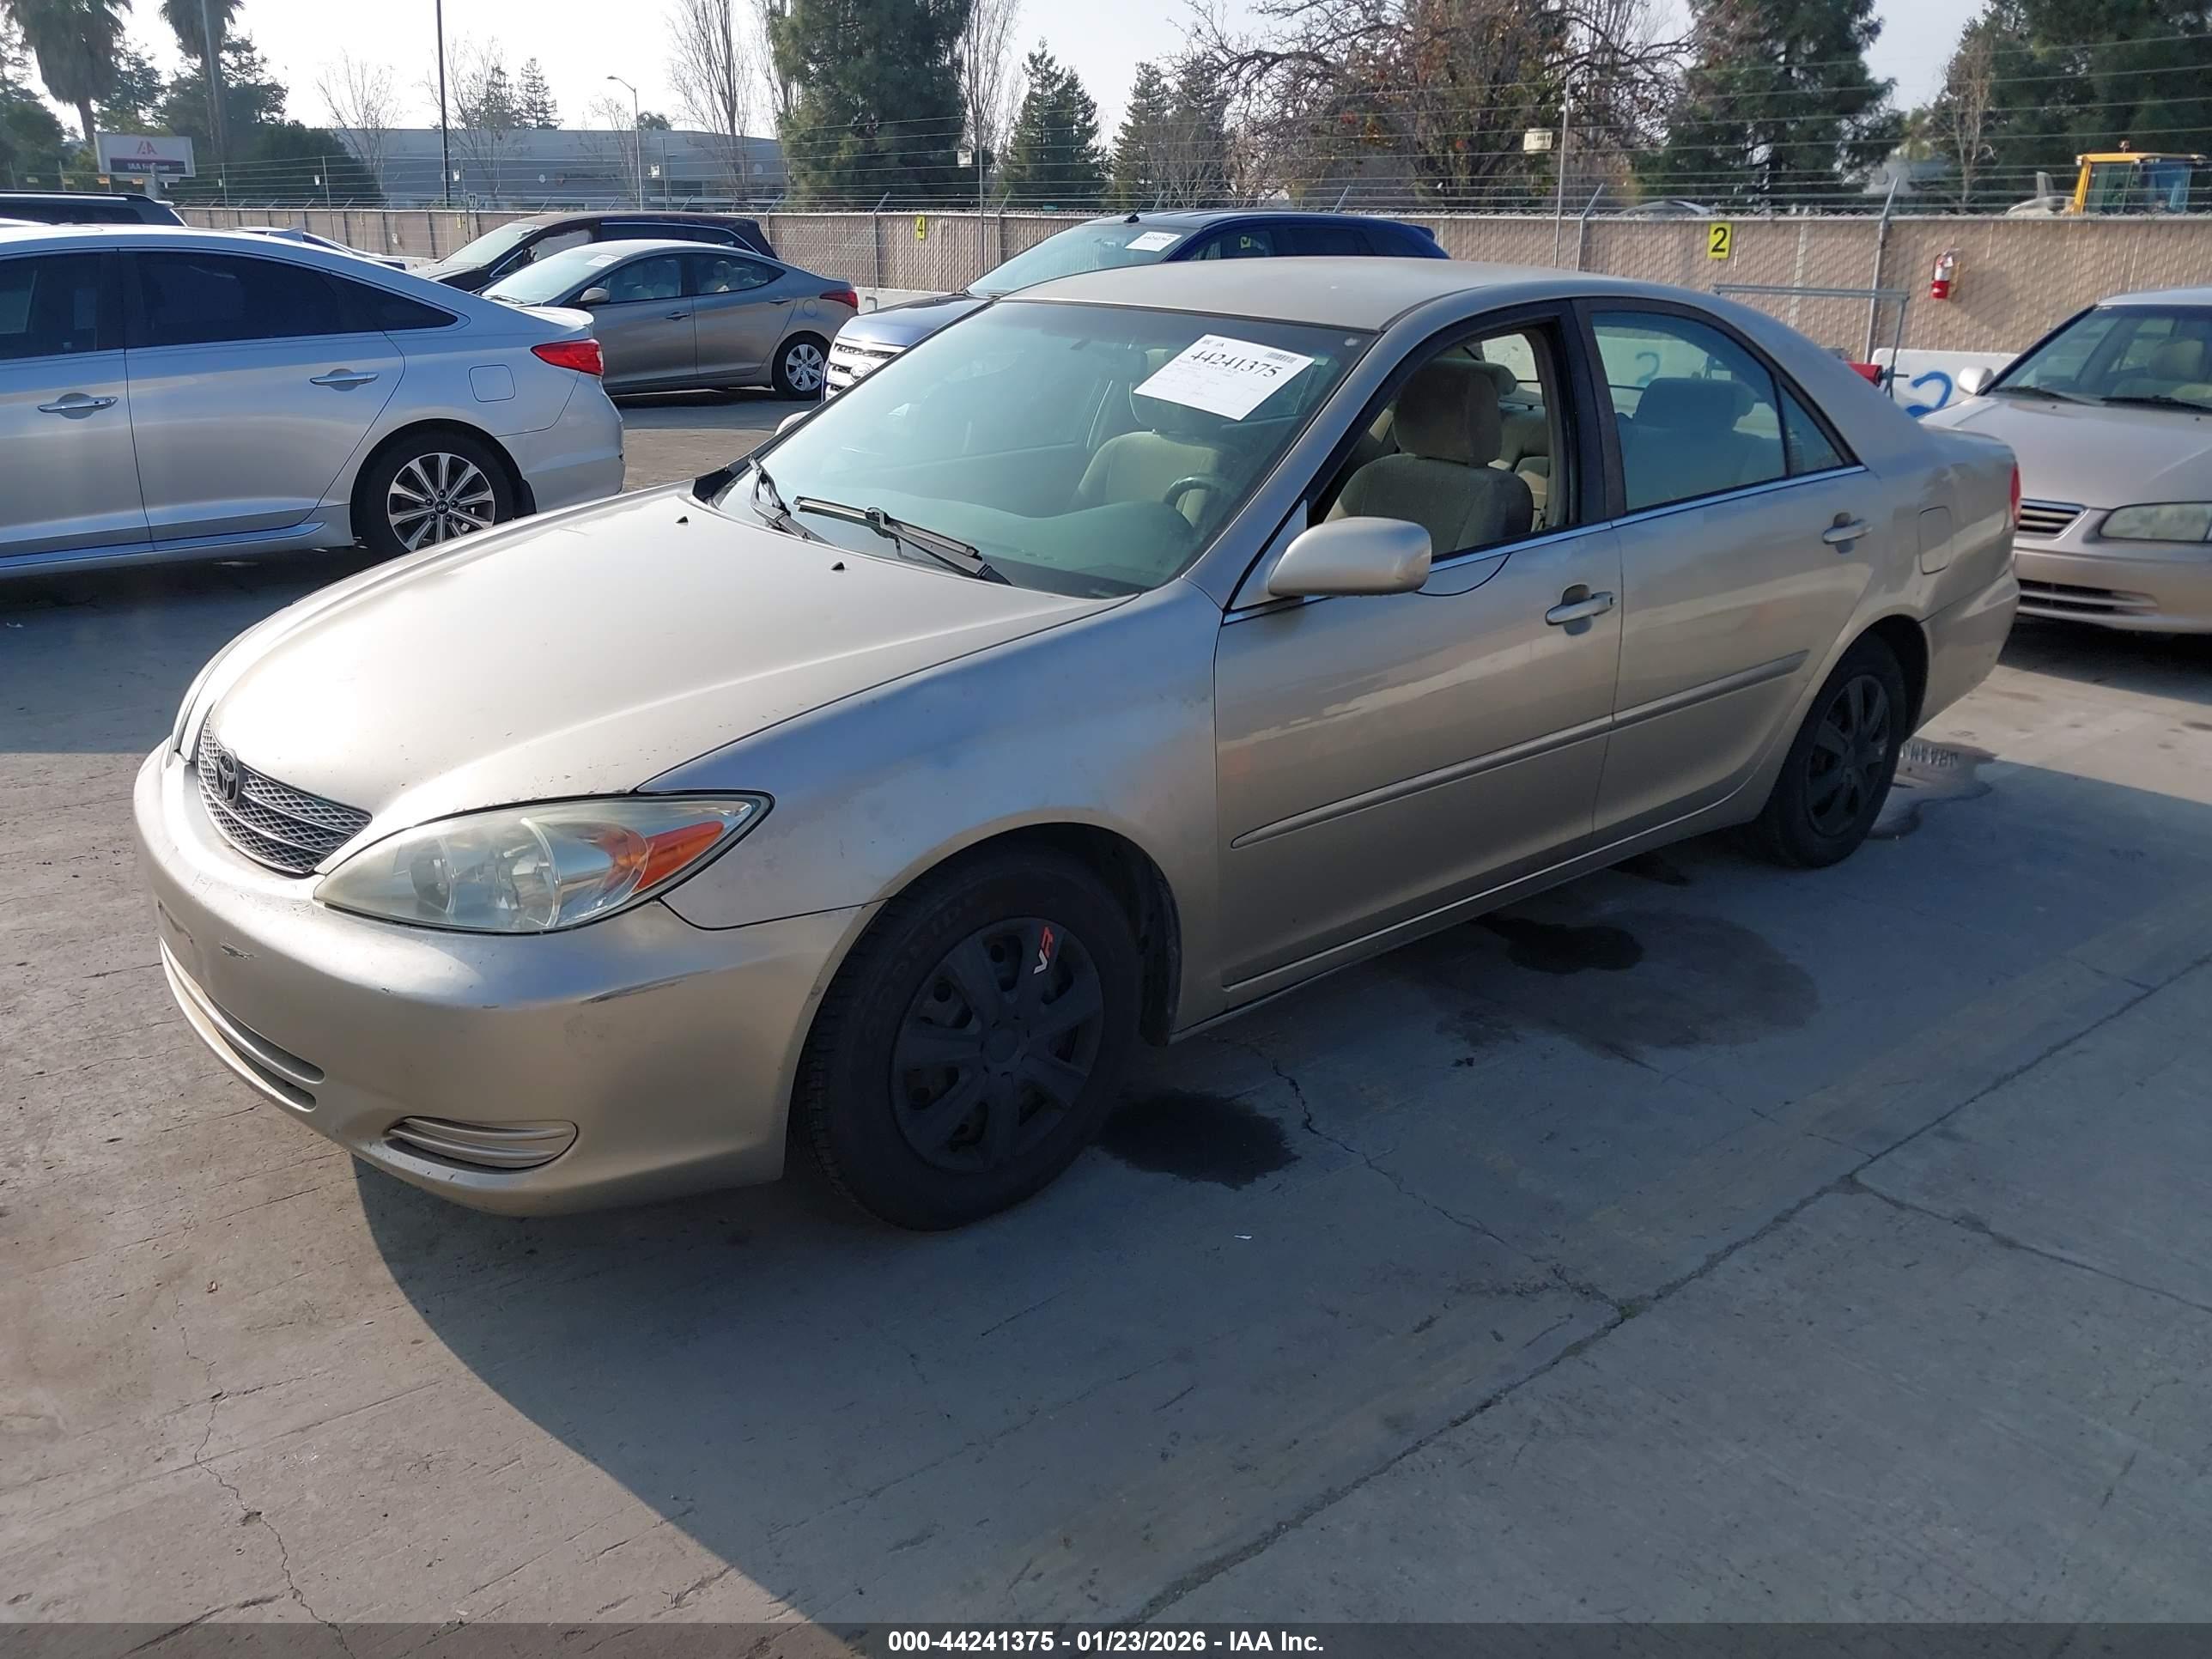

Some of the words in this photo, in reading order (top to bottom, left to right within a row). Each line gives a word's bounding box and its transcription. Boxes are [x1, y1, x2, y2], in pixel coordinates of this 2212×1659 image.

[918, 218, 923, 235] 4
[1711, 227, 1727, 252] 2
[1191, 350, 1282, 377] 44241375
[1905, 371, 1953, 417] 2
